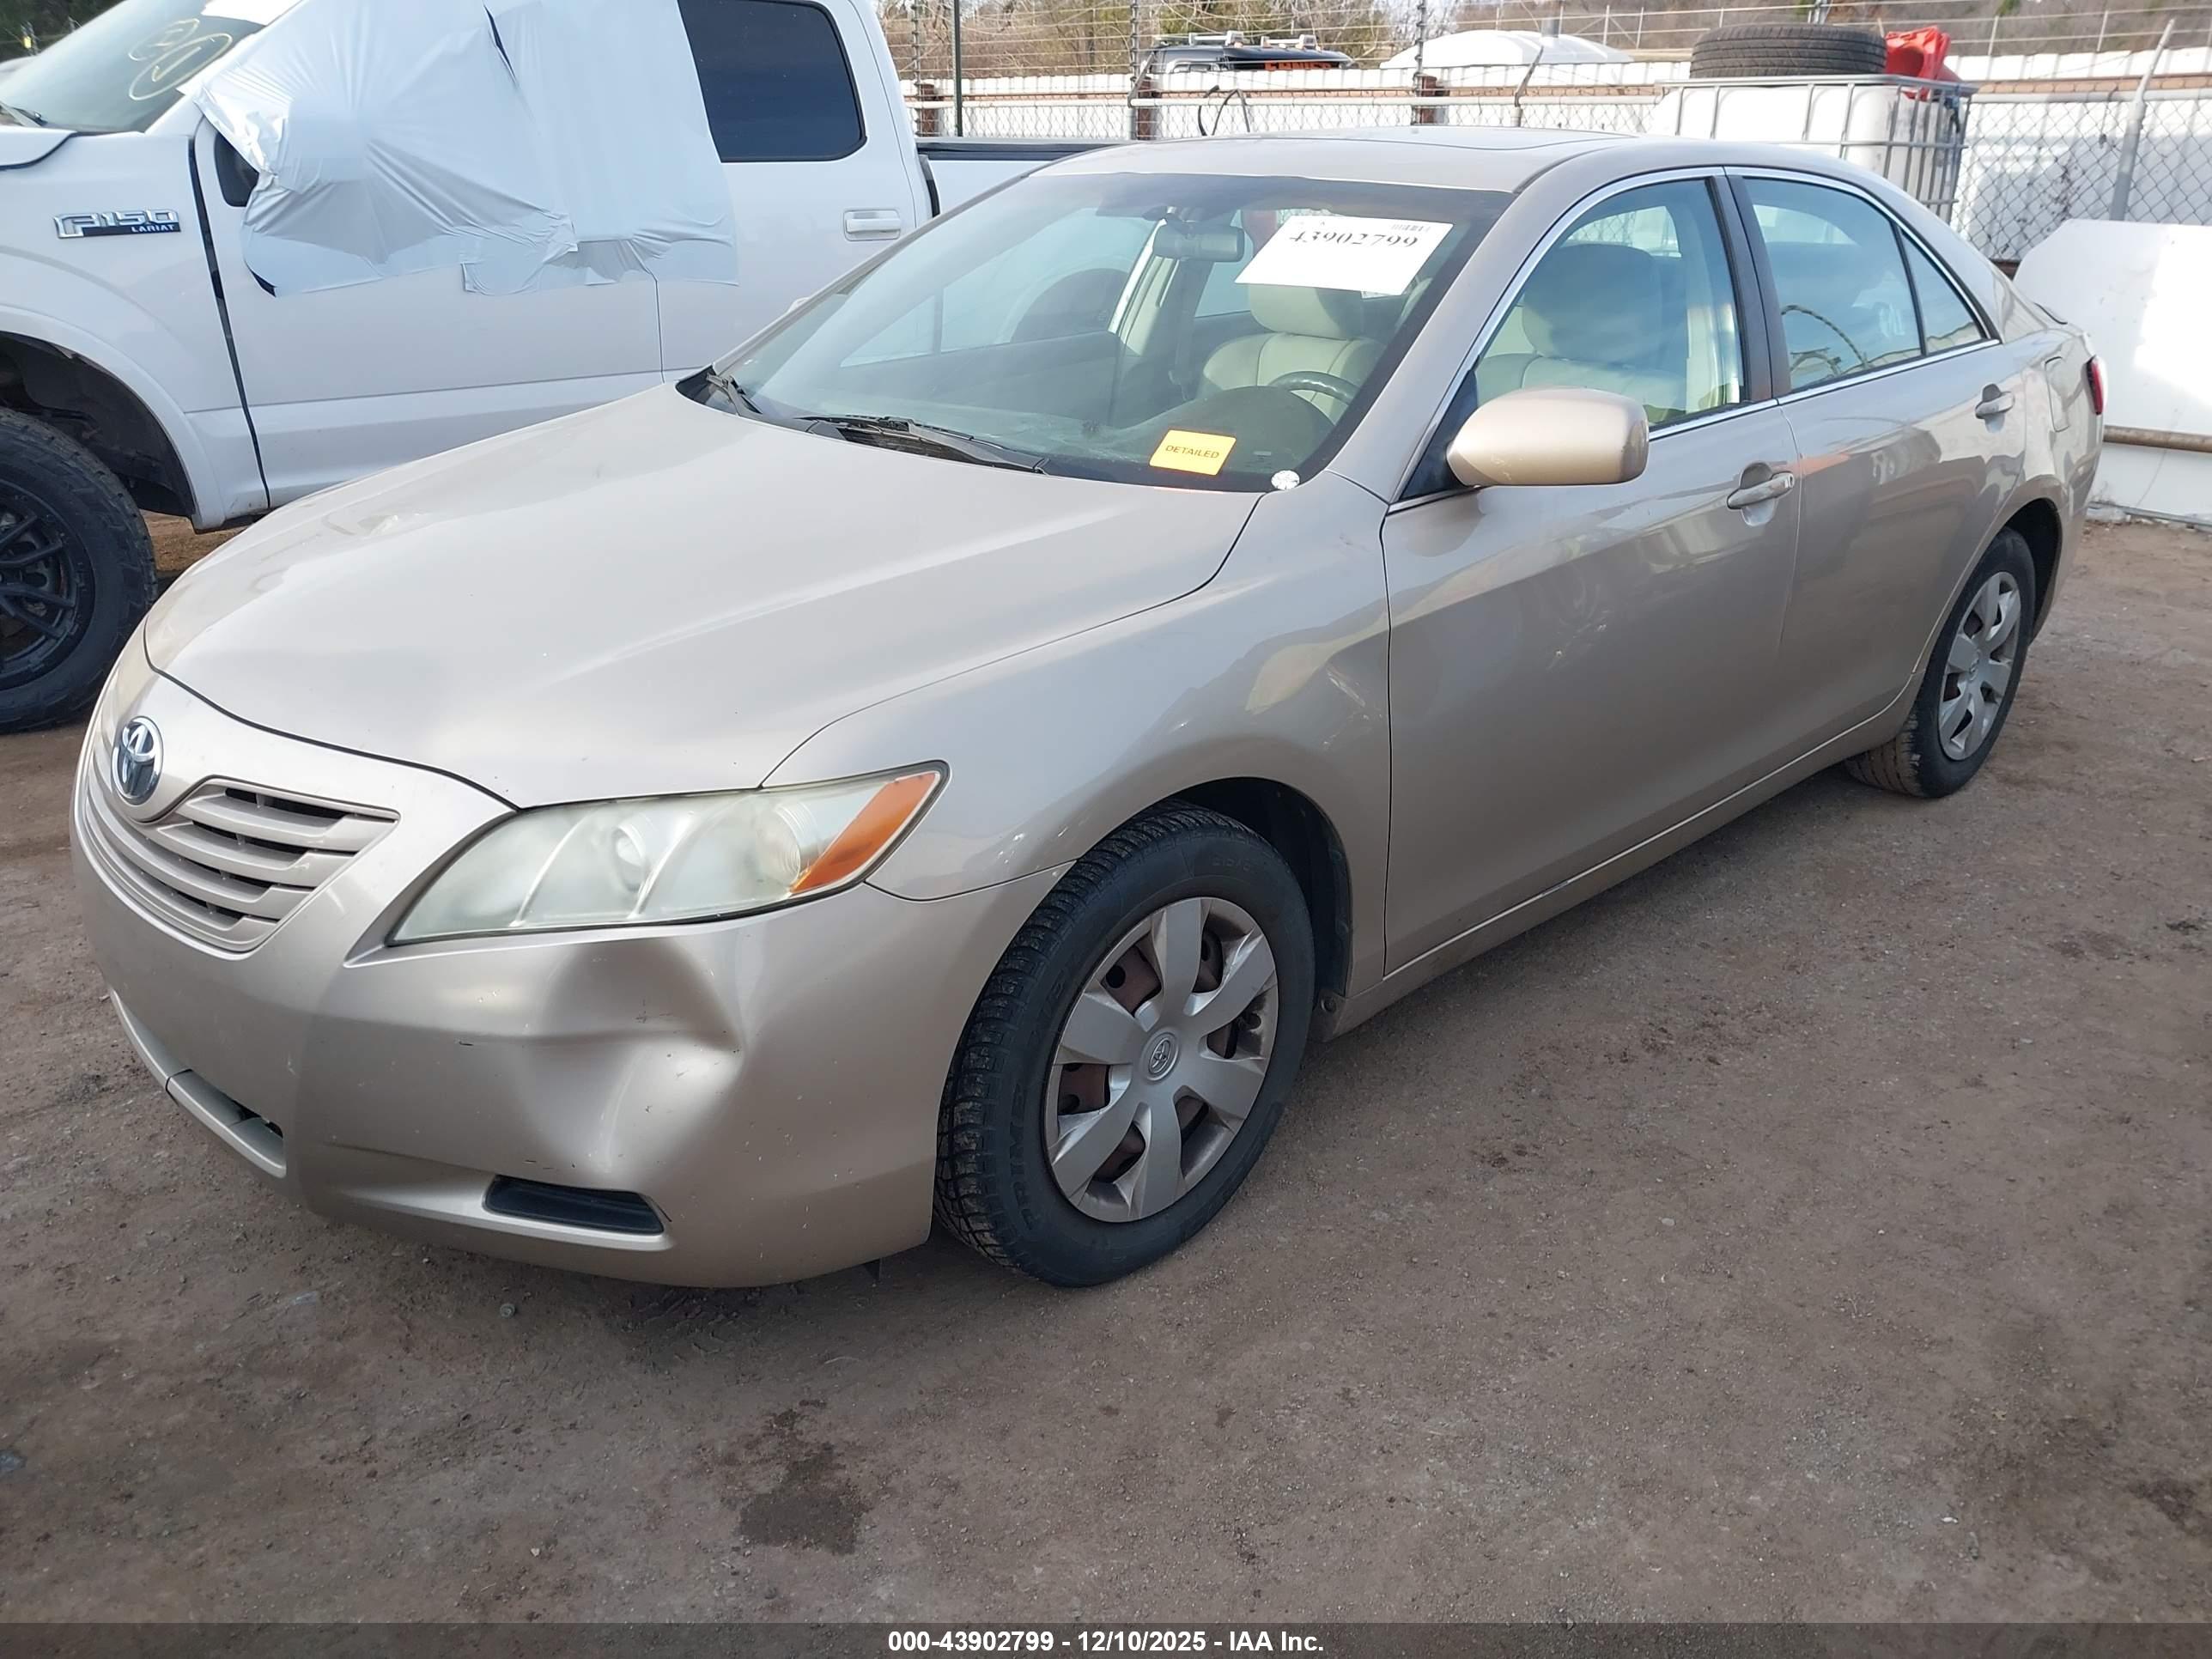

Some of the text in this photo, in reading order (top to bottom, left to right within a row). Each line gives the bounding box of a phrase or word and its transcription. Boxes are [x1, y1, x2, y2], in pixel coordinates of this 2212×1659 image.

[131, 224, 175, 234] LARIAT
[1289, 230, 1419, 248] 43902799
[1164, 444, 1220, 459] DETAILED
